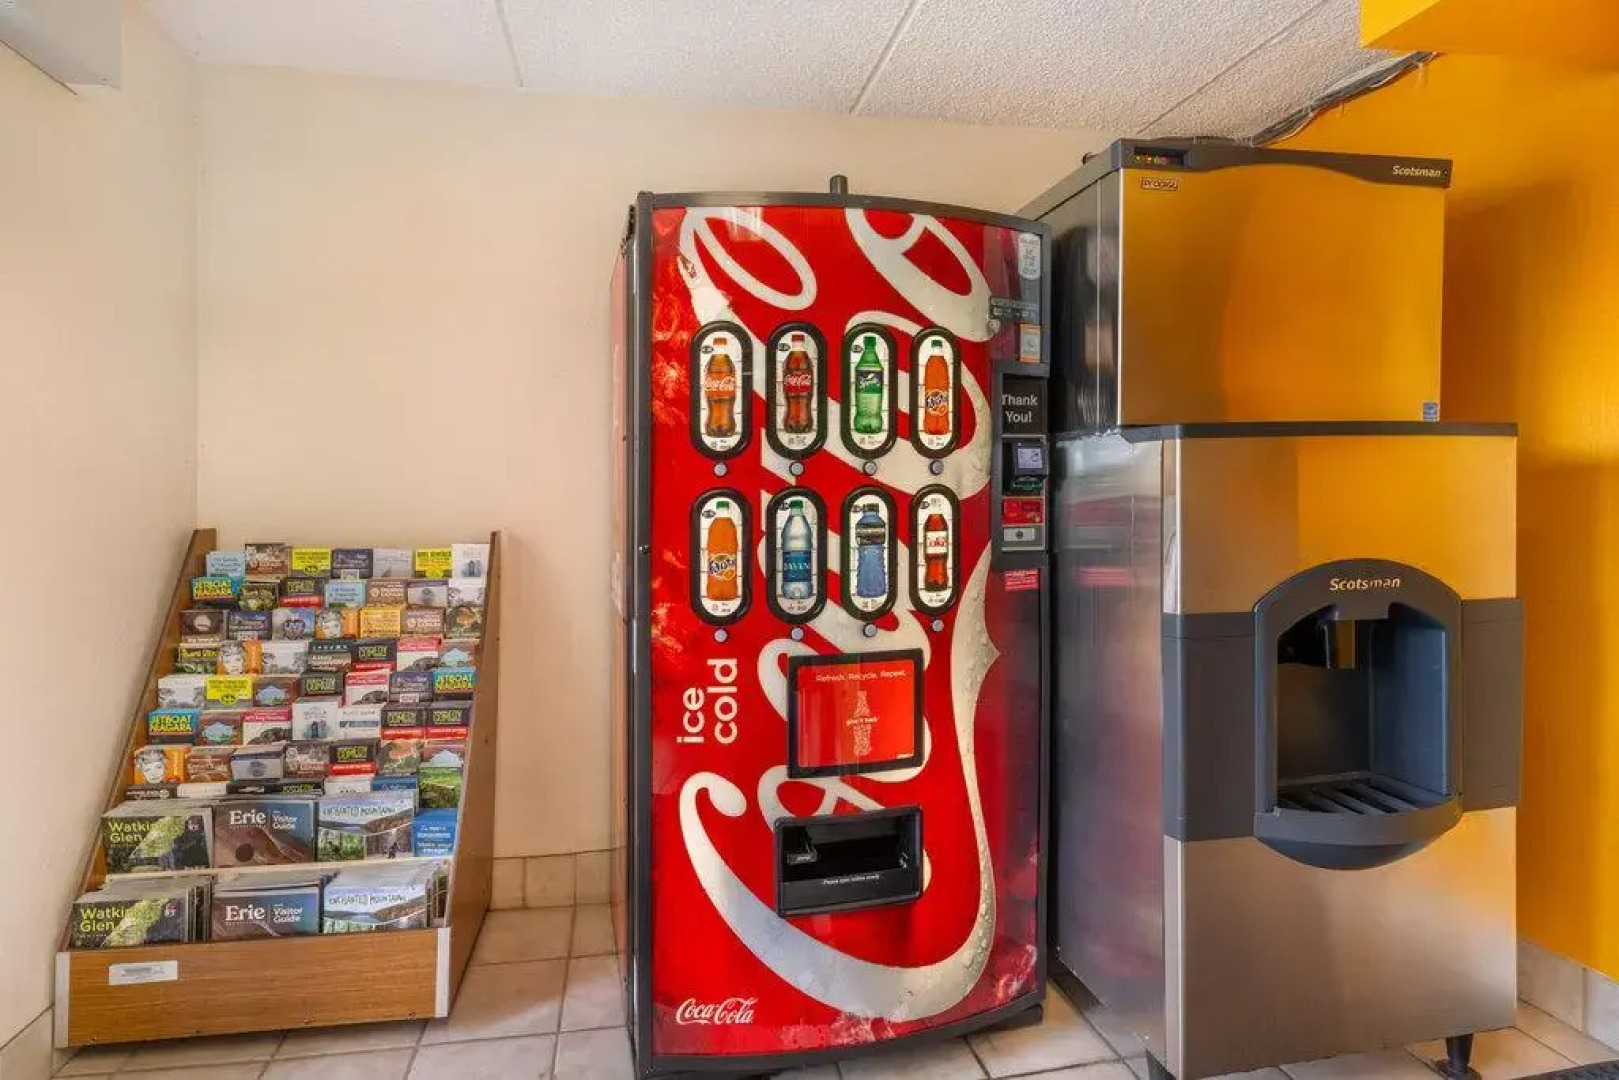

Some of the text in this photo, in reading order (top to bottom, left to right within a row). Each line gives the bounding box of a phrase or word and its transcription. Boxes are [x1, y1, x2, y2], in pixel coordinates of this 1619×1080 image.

[1392, 165, 1441, 178] Scotsman
[1002, 394, 1038, 406] Thank
[1005, 410, 1032, 423] You!
[1329, 577, 1401, 591] Scotsman
[706, 658, 738, 744] cold
[676, 687, 705, 744] ice
[229, 808, 266, 825] Erie
[110, 832, 142, 844] Glen
[225, 903, 265, 921] Erie
[80, 920, 115, 932] Glen
[675, 997, 759, 1025] Coca-Cola
